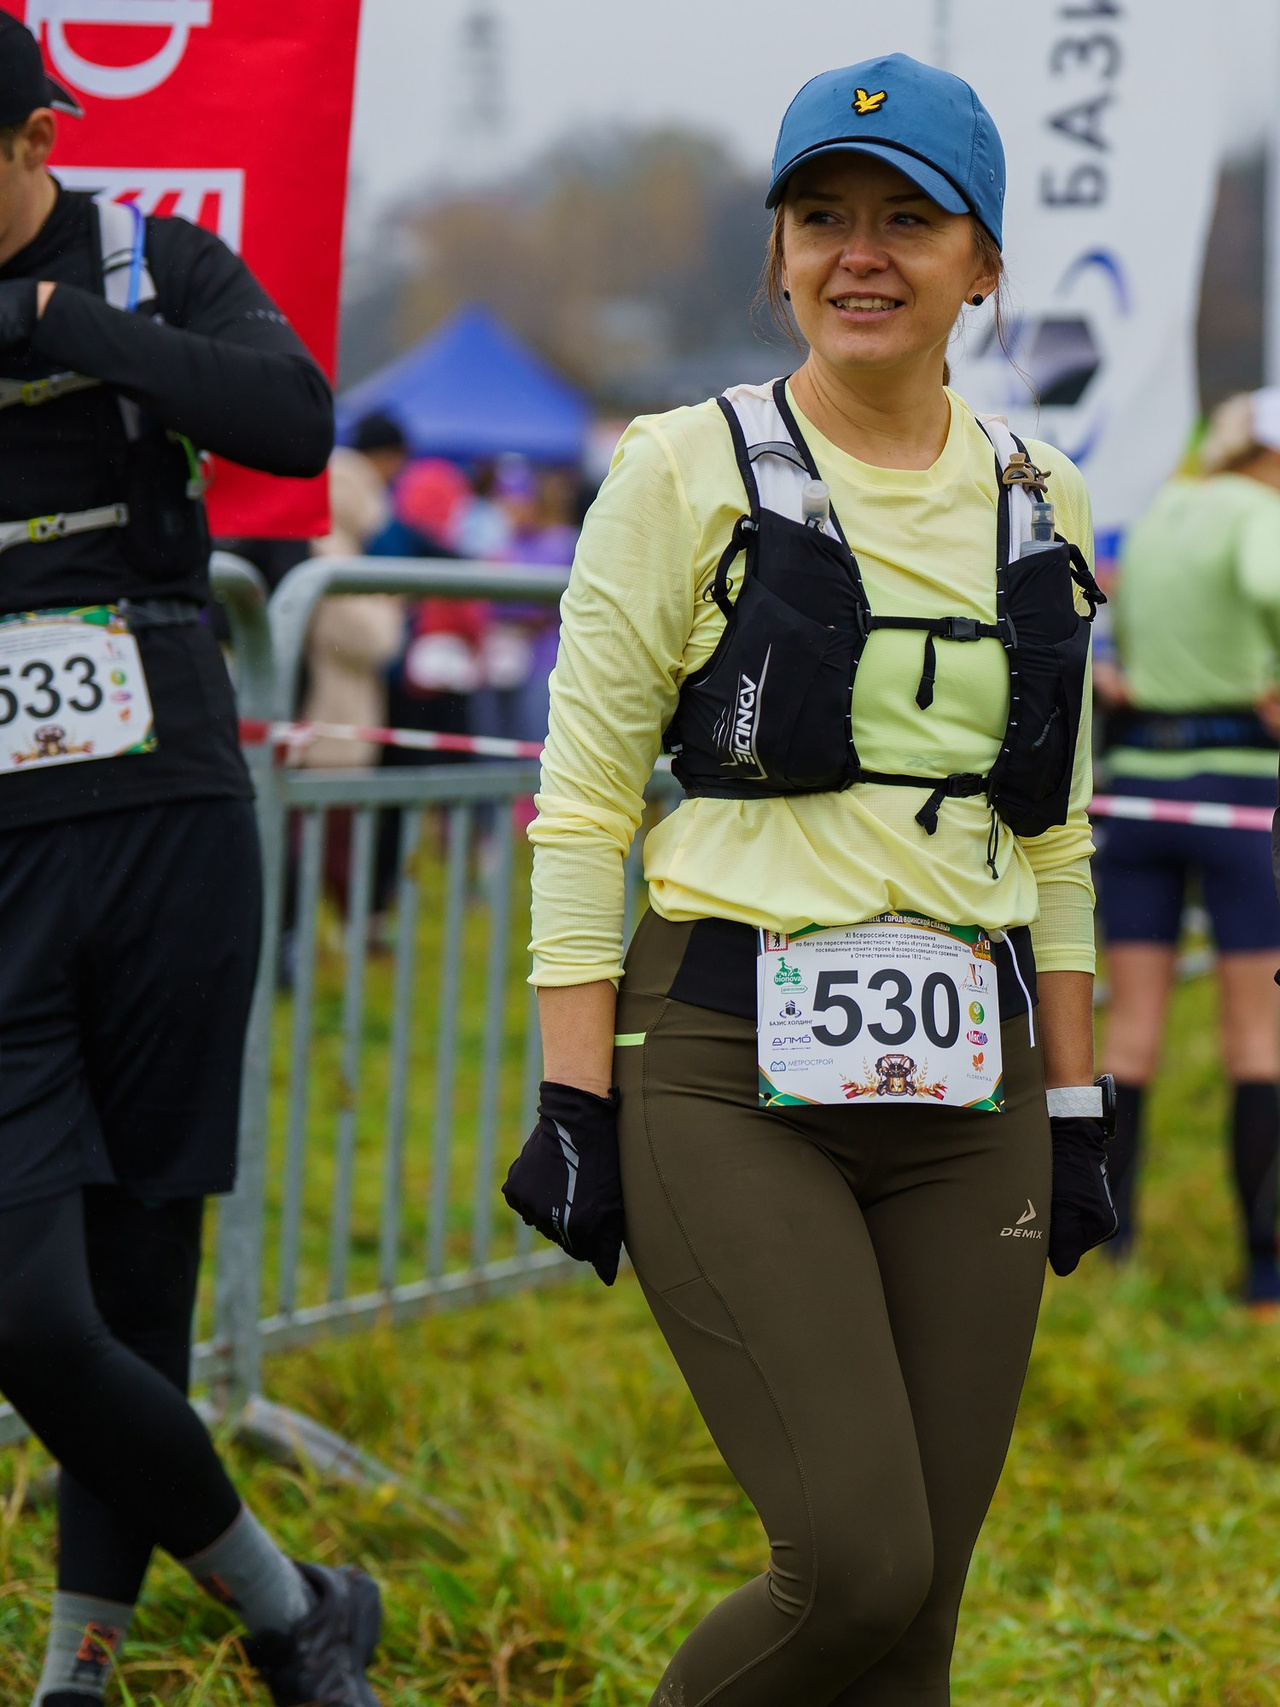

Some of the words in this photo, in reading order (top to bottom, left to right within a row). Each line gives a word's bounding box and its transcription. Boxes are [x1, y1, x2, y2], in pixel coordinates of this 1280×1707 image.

[774, 974, 802, 982] bionova
[811, 968, 960, 1048] 530
[788, 1058, 834, 1066] МЕТРОСТРОЙ
[1000, 1228, 1042, 1239] DEMIX
